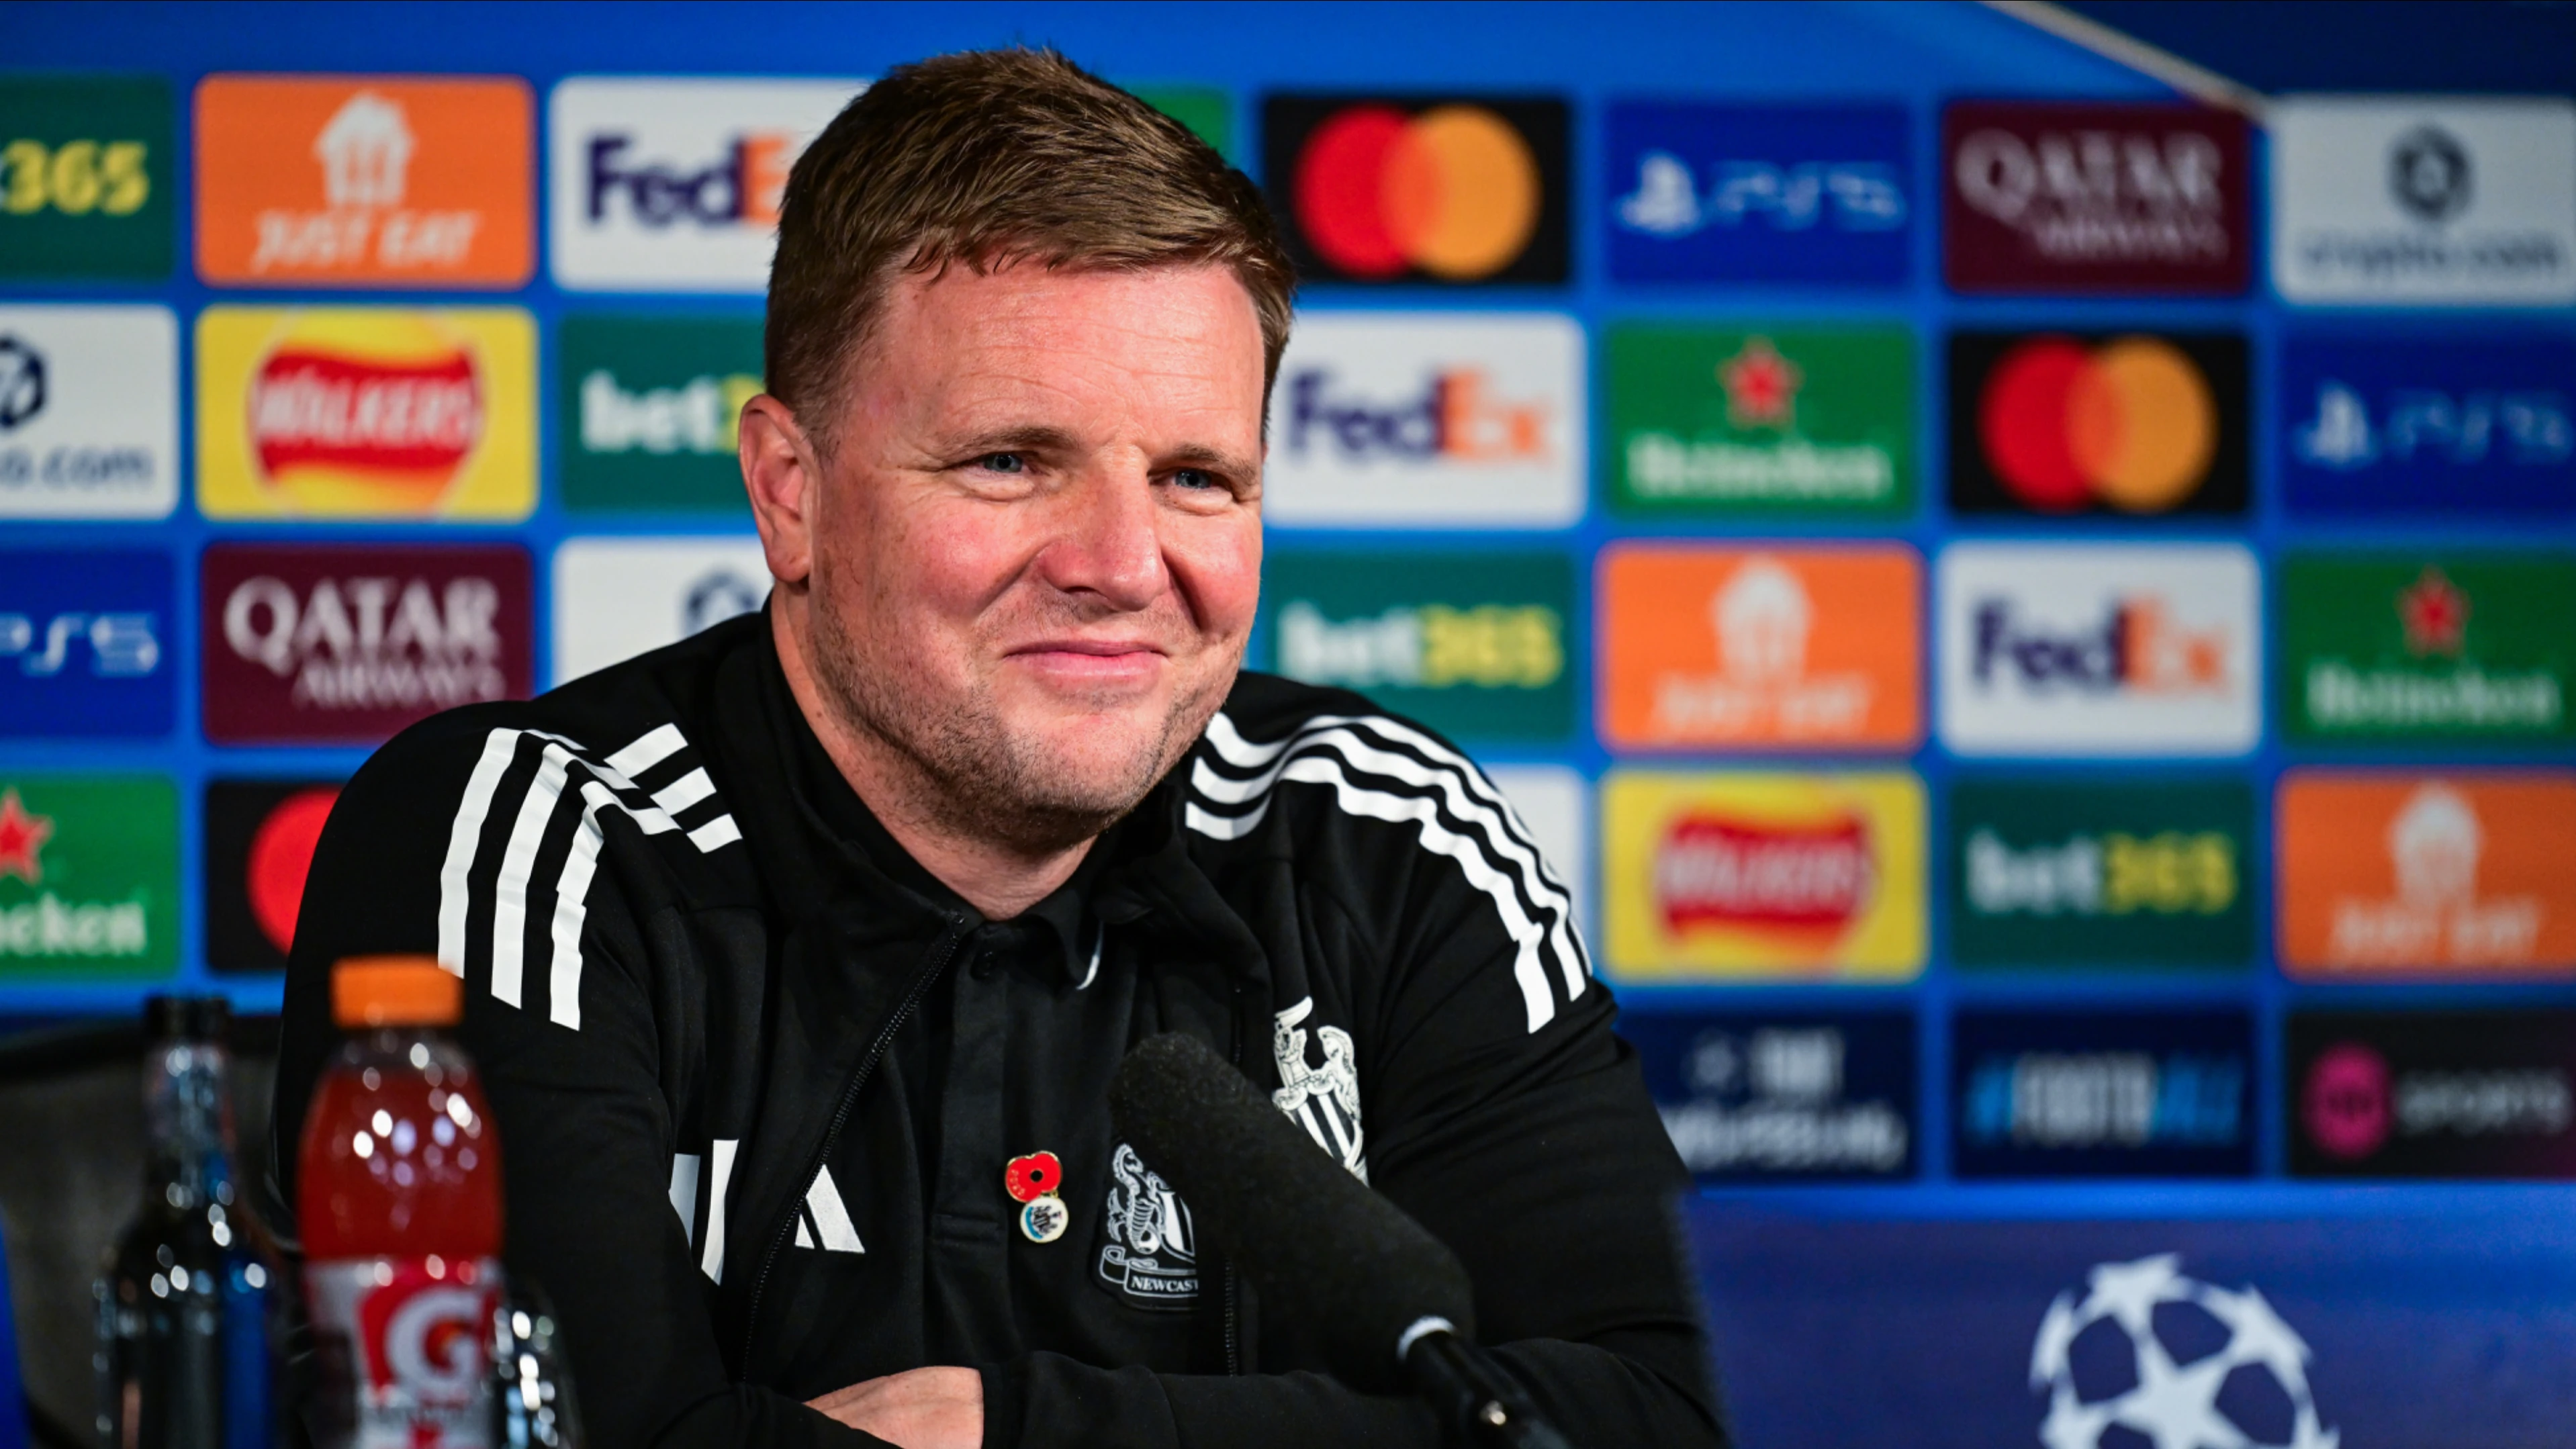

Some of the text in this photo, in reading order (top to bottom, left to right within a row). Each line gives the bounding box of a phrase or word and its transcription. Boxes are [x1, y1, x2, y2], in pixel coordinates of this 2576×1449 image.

[0, 140, 150, 216] 365
[586, 133, 787, 227] FedE
[1956, 128, 2221, 224] QATAR
[255, 365, 482, 450] WALKERS
[582, 370, 766, 454] bet3
[1290, 369, 1551, 465] FedEx
[1626, 431, 1894, 500] Heineken
[224, 576, 499, 673] QATAR
[1279, 600, 1563, 688] bet365
[1972, 596, 2228, 698] FedEx
[294, 663, 505, 709] AIRWAYS
[1967, 827, 2238, 916] bet365
[0, 892, 146, 956] eken
